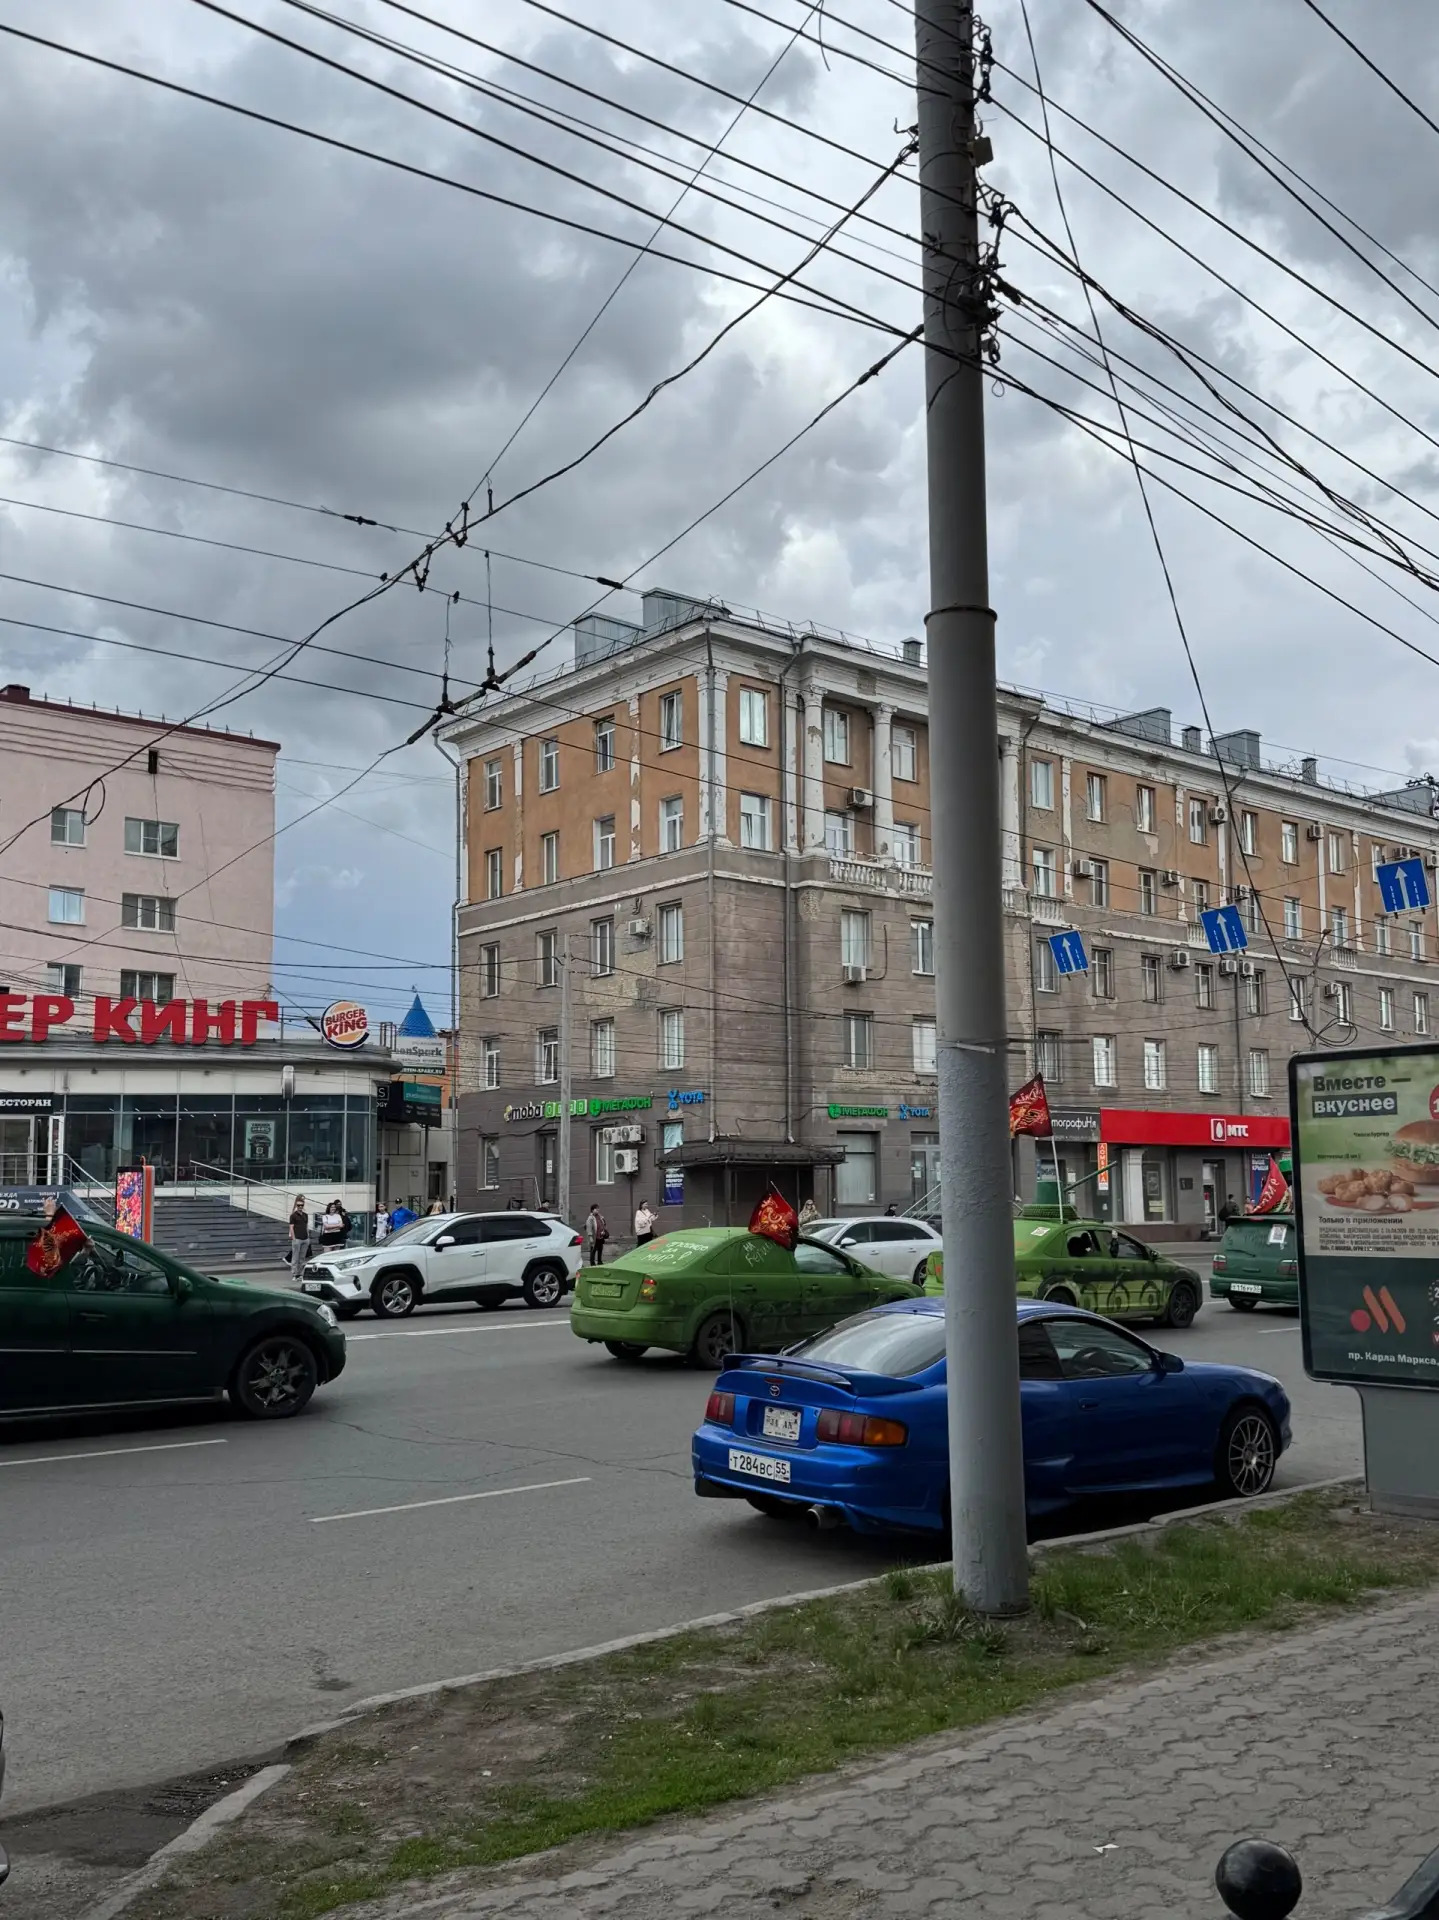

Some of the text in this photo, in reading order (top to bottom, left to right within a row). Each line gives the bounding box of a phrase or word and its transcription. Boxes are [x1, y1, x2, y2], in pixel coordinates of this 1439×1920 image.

[92, 996, 279, 1046] КИНГ
[325, 1008, 366, 1026] BURGER
[327, 1017, 368, 1039] KING
[1313, 1075, 1386, 1092] Вместе
[378, 1087, 386, 1097] S
[0, 1099, 52, 1107] ЕСТОРАН
[601, 1097, 652, 1113] МЕГАФОН
[1314, 1097, 1396, 1116] вкуснее
[842, 1107, 889, 1117] МЕГАФОН
[1227, 1124, 1249, 1137] МТС
[1348, 1352, 1364, 1361] пр.
[1365, 1351, 1396, 1362] Карла
[775, 1462, 787, 1475] 55
